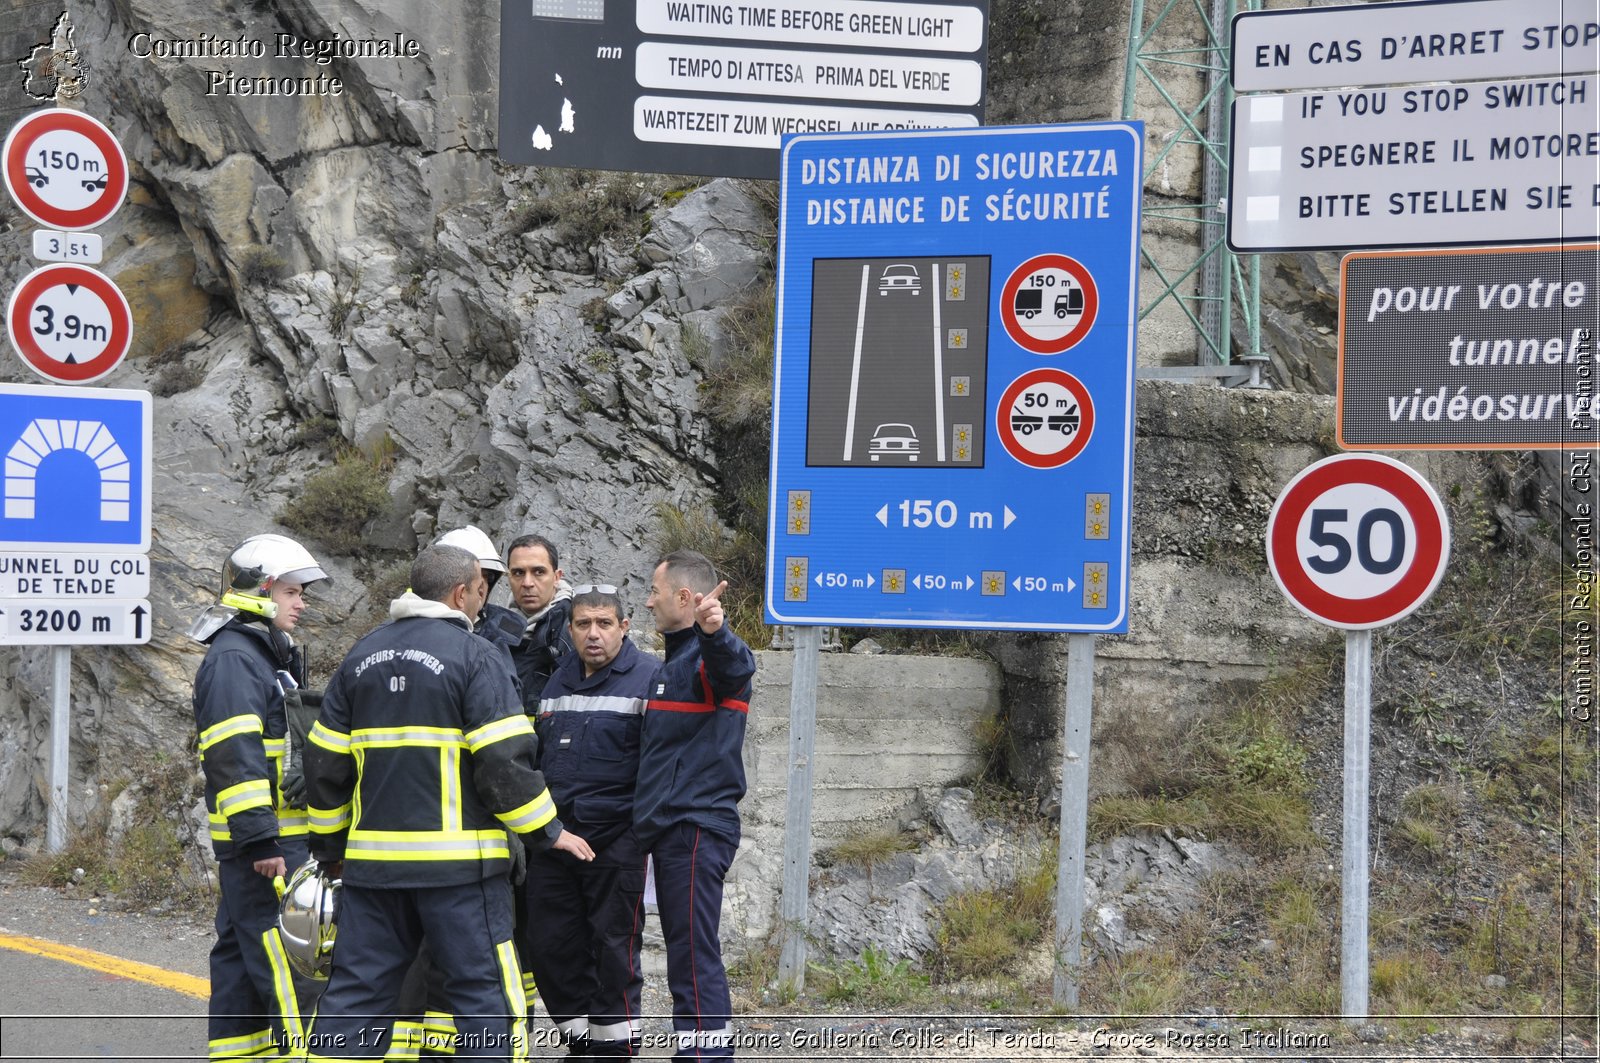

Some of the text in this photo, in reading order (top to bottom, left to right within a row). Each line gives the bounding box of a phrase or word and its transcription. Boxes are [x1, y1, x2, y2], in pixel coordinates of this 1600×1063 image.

[667, 2, 953, 38] WAITING TIME BEFORE GREEN LIGHT
[597, 46, 622, 59] mn
[1255, 23, 1600, 68] EN CAS D'ARRET STOP
[668, 57, 950, 91] TEMPO DI ATTESA PRIMA DEL VERDE
[1301, 80, 1586, 118] IF YOU STOP SWITCH
[643, 109, 730, 134] WARTEZEIT
[734, 115, 767, 135] ZUM
[1300, 132, 1600, 169] SPEGNERE IL MOTORE
[802, 149, 1118, 185] DISTANZA DI SICUREZZA
[807, 185, 1110, 226] DISTANCE DE SÉCURITÉ
[1299, 194, 1370, 218] BITTE
[1388, 188, 1507, 215] STELLEN
[1526, 185, 1572, 210] SIE
[1029, 275, 1071, 288] 150 m
[1367, 277, 1585, 322] pour votre
[34, 305, 107, 343] 3,9m
[1448, 328, 1582, 366] tunnel
[1024, 393, 1067, 408] 50 m
[899, 499, 993, 529] 150 m
[1306, 507, 1406, 575] 50
[74, 559, 99, 575] DU
[110, 560, 145, 575] COL
[826, 573, 864, 588] 50 m
[924, 575, 963, 590] 50 m
[18, 578, 115, 594] DE TENDE
[1024, 577, 1064, 592] 50 m
[20, 609, 111, 632] 3200 m
[389, 676, 406, 692] 06
